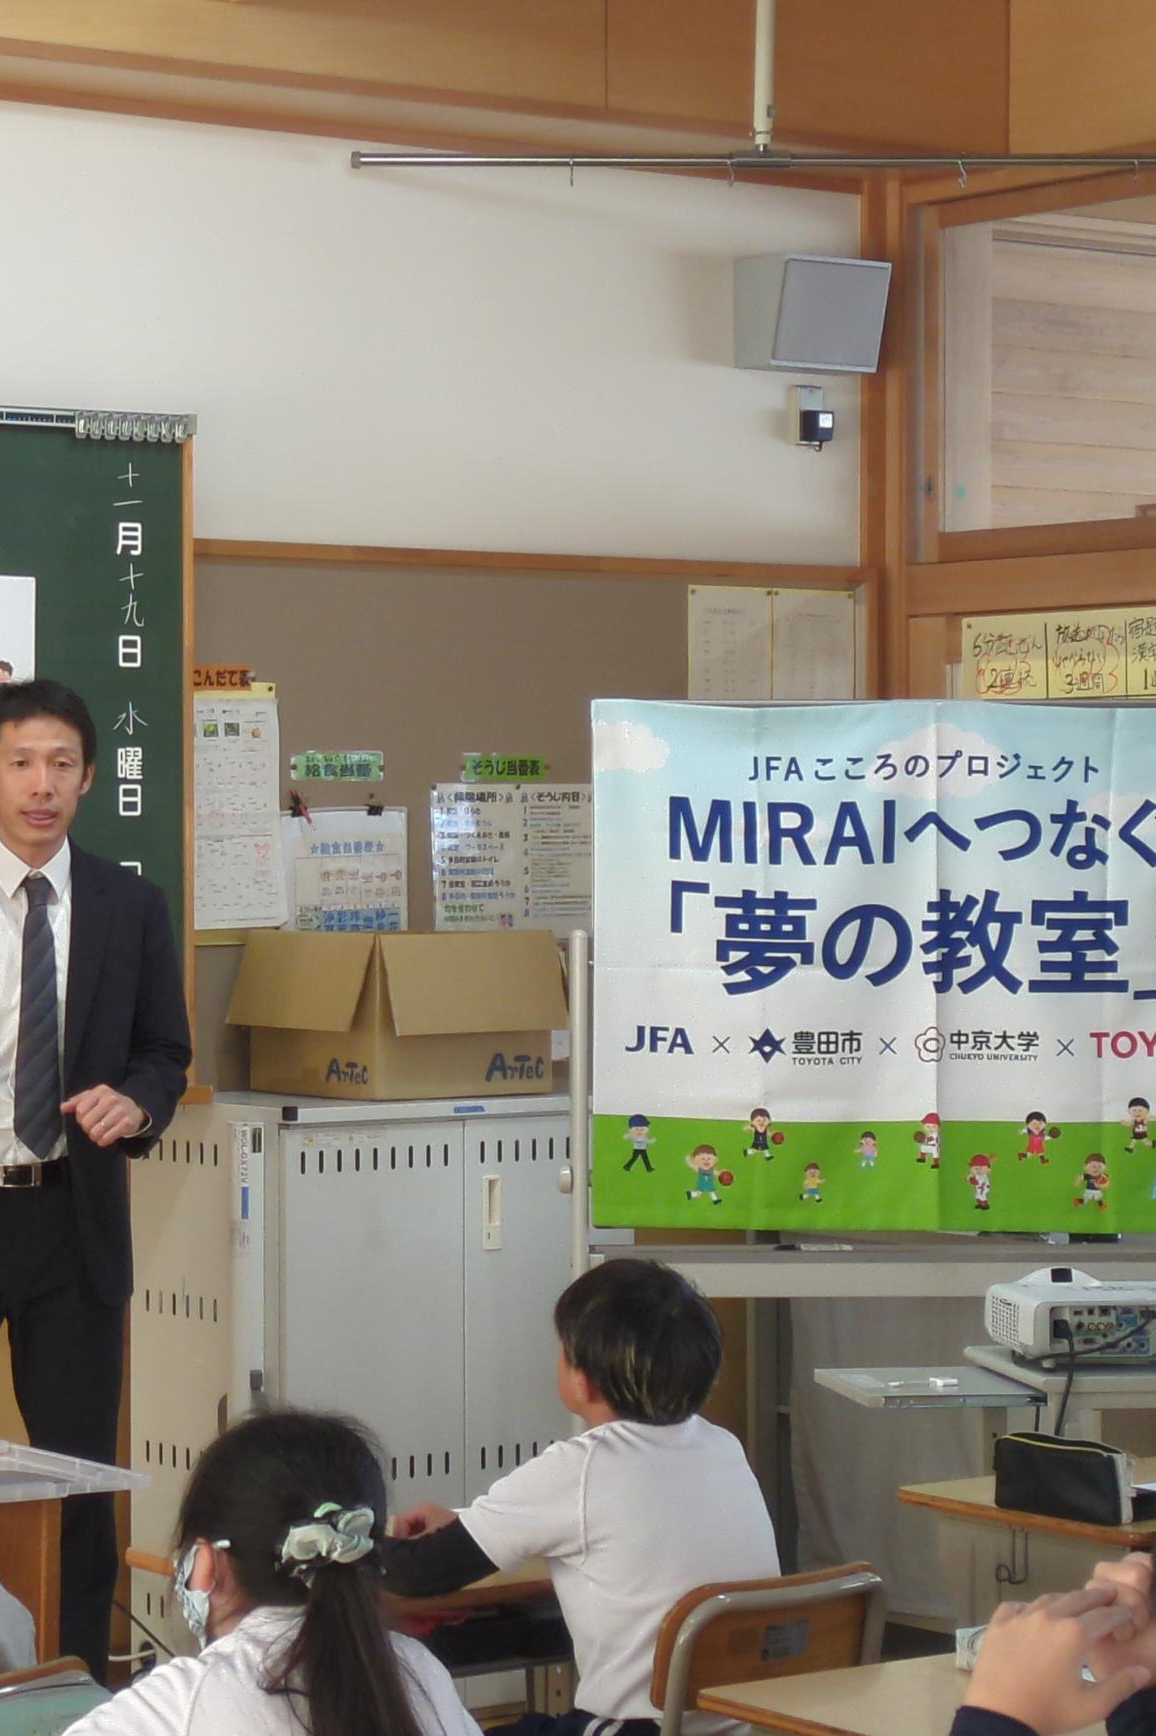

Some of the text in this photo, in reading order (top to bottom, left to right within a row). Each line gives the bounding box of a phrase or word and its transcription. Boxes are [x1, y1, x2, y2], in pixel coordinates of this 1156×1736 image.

[625, 1025, 694, 1055] JFA
[792, 1030, 863, 1055] 豊田市
[950, 1030, 1040, 1051] 中京大学
[792, 1056, 863, 1065] TOYOTA CITY
[987, 1053, 1038, 1062] UNIVERSITY
